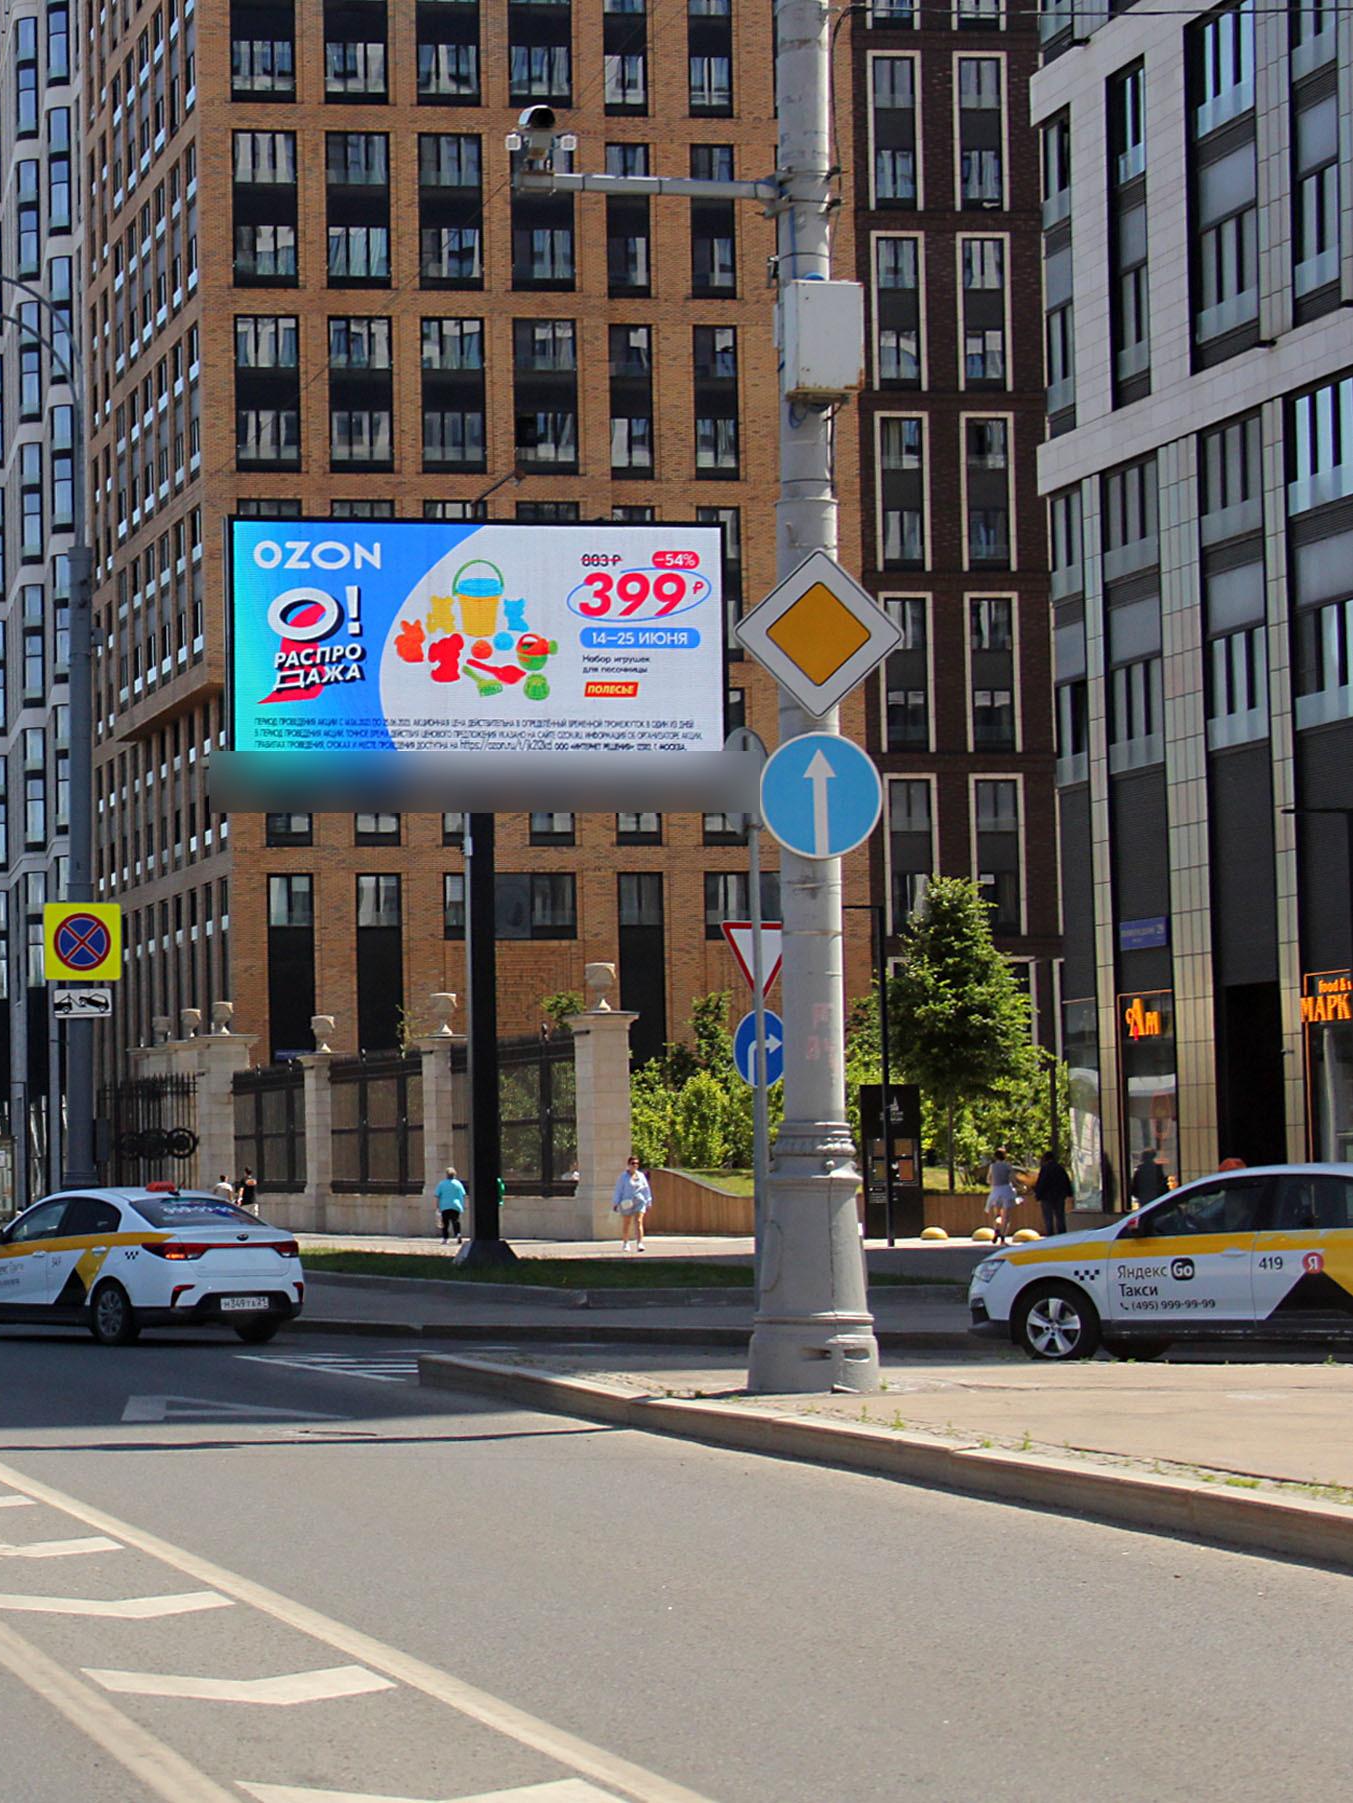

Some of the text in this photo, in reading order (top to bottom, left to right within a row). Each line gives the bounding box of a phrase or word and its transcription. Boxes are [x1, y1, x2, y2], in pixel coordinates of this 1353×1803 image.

[253, 539, 381, 569] OZON
[579, 572, 686, 617] 399
[639, 632, 688, 645] ИЮНЯ
[274, 643, 362, 668] РАСПРО
[582, 655, 611, 664] Набор
[273, 663, 361, 692] ДАЖА
[587, 685, 635, 695] ПОЛЕСЬЕ
[1259, 1257, 1283, 1270] 419
[1307, 1256, 1319, 1271] Я
[1118, 1264, 1193, 1279] Яндекс Go
[1119, 1284, 1158, 1297] Такси
[1131, 1299, 1216, 1311] (495) 999-99-99
